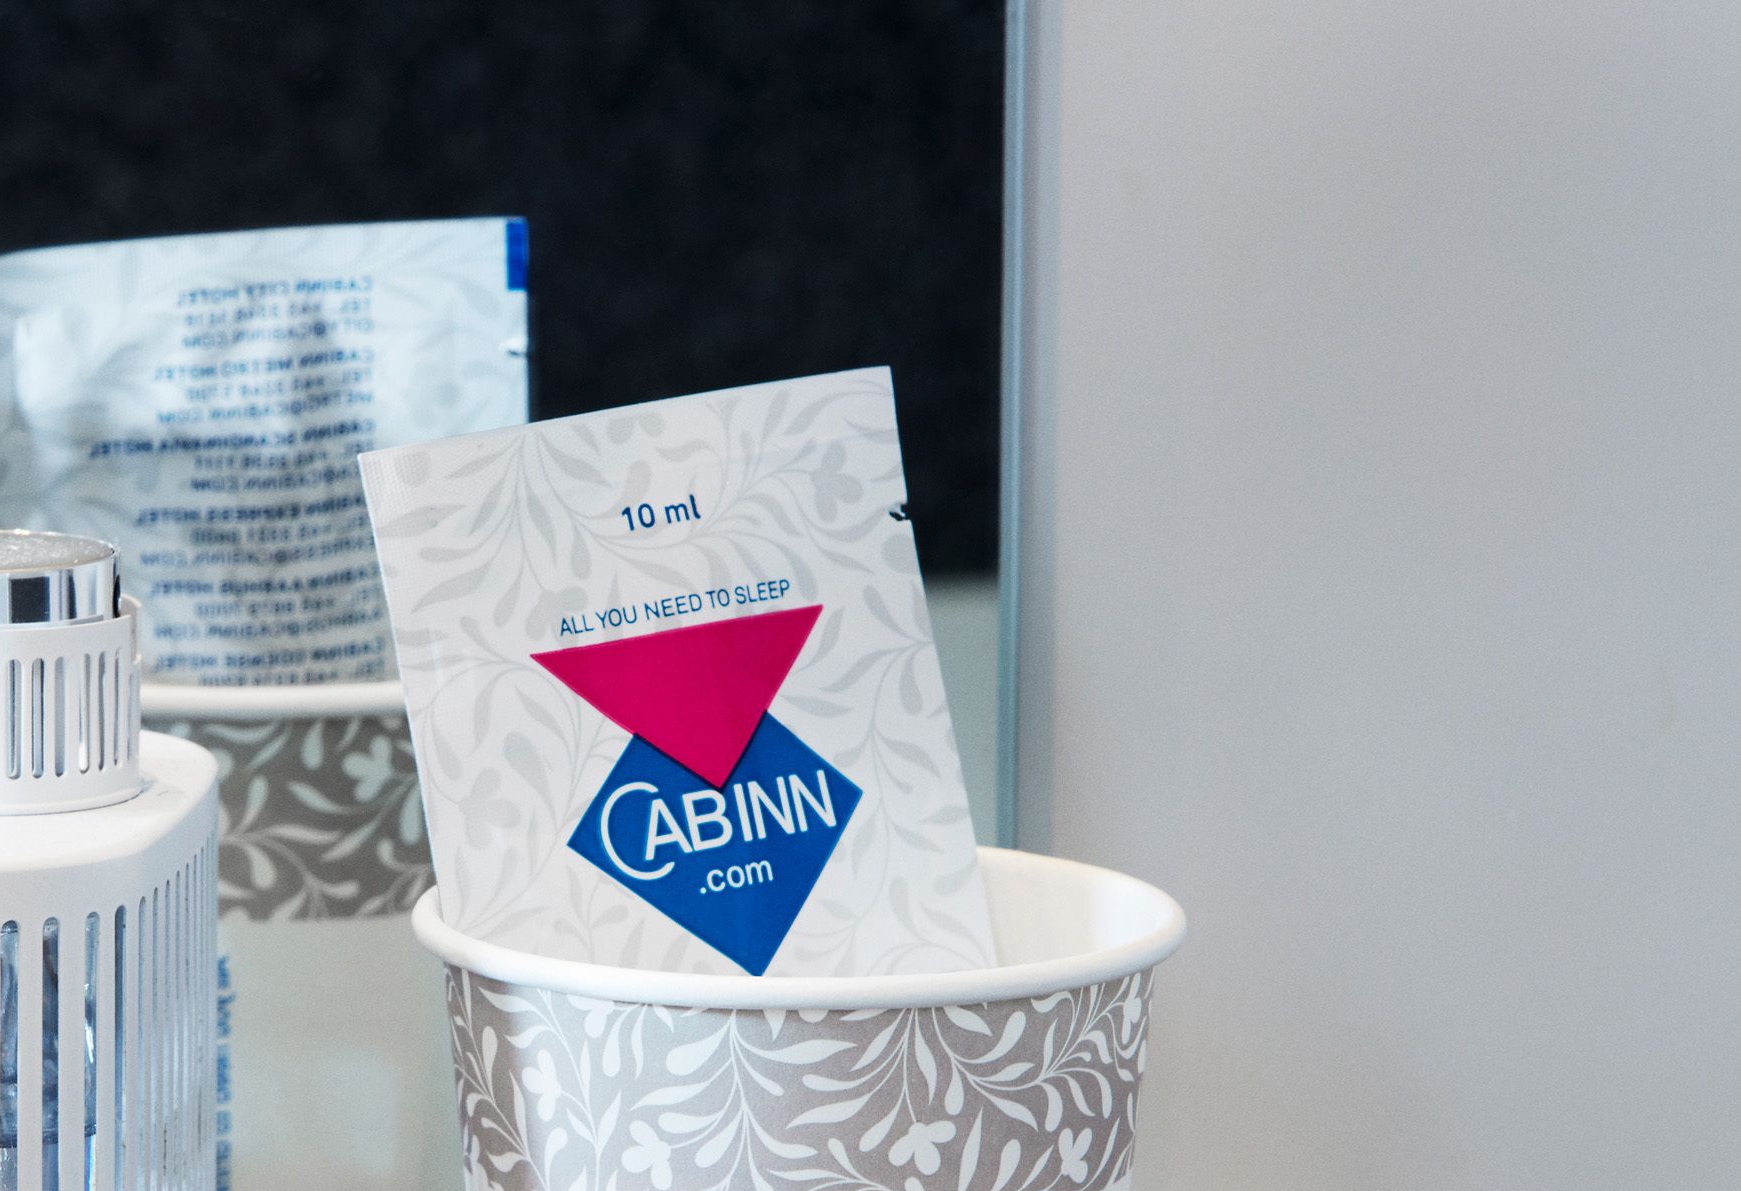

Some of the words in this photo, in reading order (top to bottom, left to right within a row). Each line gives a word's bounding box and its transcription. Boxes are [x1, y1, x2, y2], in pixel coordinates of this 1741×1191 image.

[621, 502, 656, 532] 10
[664, 494, 702, 525] ml
[560, 614, 596, 637] ALL
[595, 605, 638, 629] YOU
[644, 593, 703, 621] NEED
[705, 588, 731, 609] TO
[734, 579, 791, 605] SLEEP
[600, 769, 838, 881] CABINN
[699, 859, 774, 895] .com
